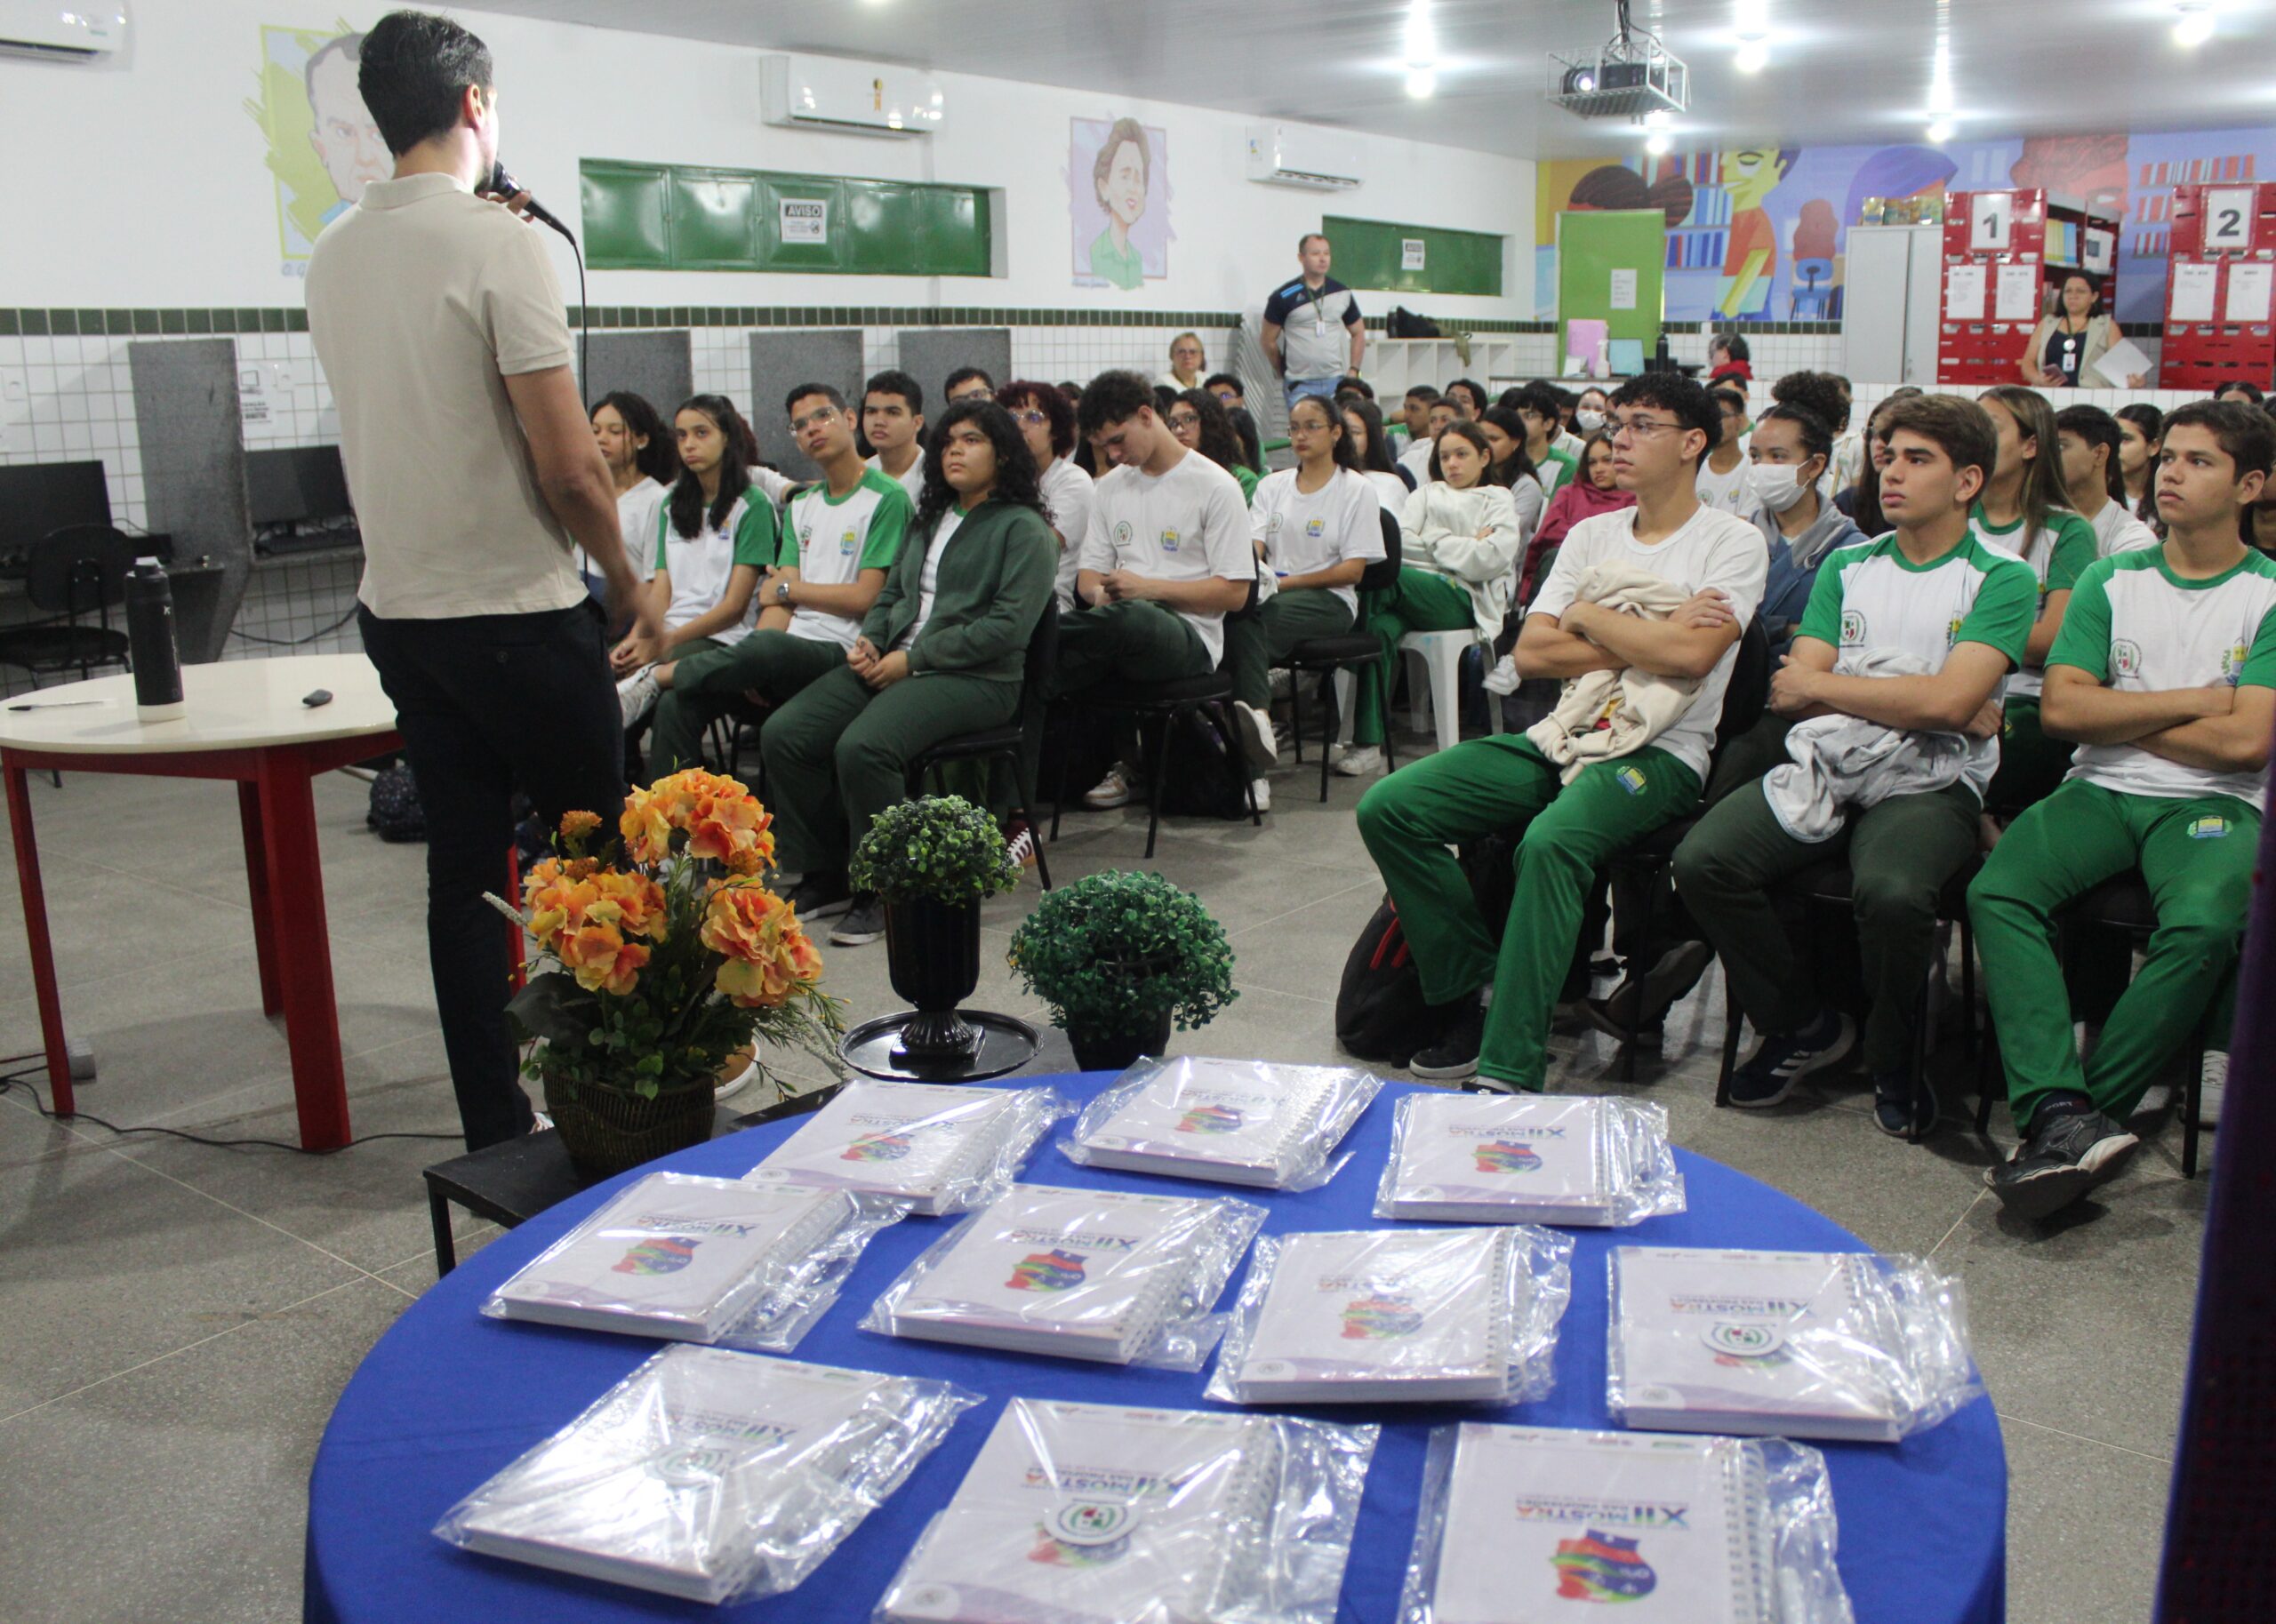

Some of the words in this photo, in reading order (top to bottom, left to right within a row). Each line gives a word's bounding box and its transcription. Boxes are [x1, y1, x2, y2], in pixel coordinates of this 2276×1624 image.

[788, 205, 821, 217] AVISO
[1983, 212, 1998, 238] 1
[2216, 209, 2240, 236] 2
[1449, 1130, 1526, 1139] MOSTRA
[1528, 1128, 1566, 1140] XII
[712, 1223, 757, 1239] XII
[1010, 1233, 1091, 1248] MOSTRA
[1094, 1236, 1139, 1252] XII
[1670, 1303, 1765, 1316] MOSTRA
[1767, 1300, 1816, 1319] XII
[742, 1425, 797, 1445] XII
[1024, 1473, 1131, 1493] MOSTA
[1515, 1506, 1629, 1524] MOSTRA
[1634, 1506, 1690, 1528] XII
